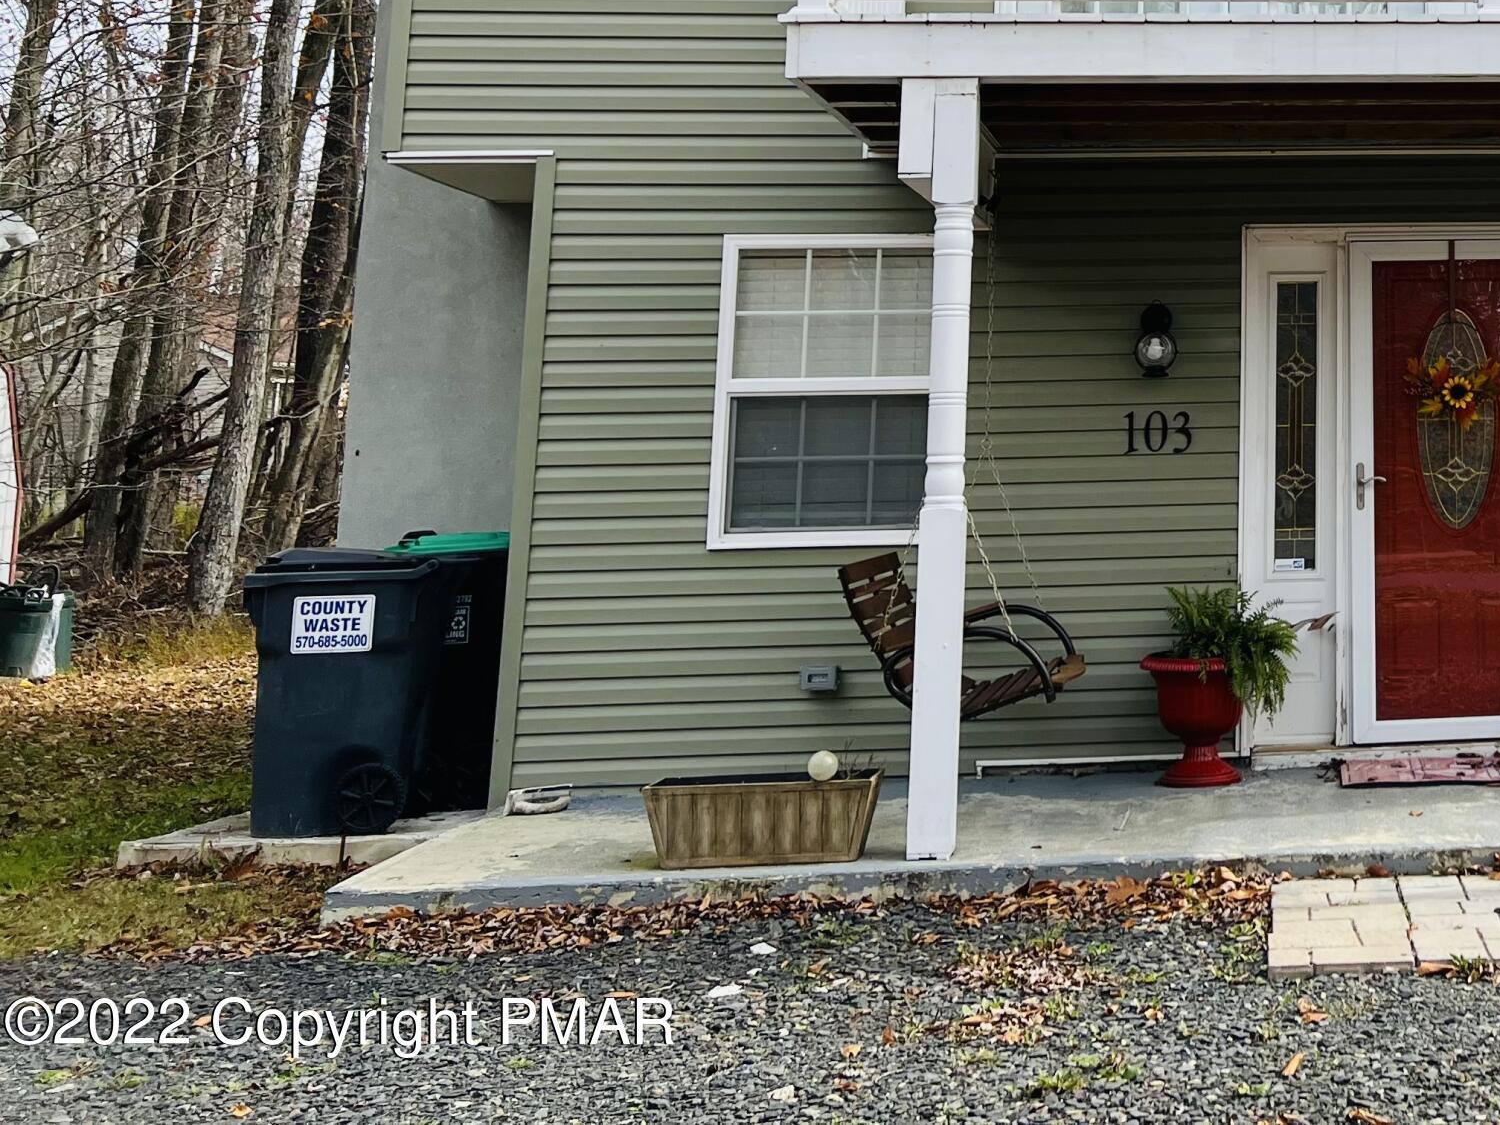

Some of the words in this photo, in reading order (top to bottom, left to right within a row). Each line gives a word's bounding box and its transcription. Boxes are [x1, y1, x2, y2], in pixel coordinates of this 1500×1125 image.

[1123, 410, 1192, 455] 103
[300, 600, 367, 615] COUNTY
[304, 618, 361, 632] WASTE
[295, 634, 367, 648] 570-685-5000
